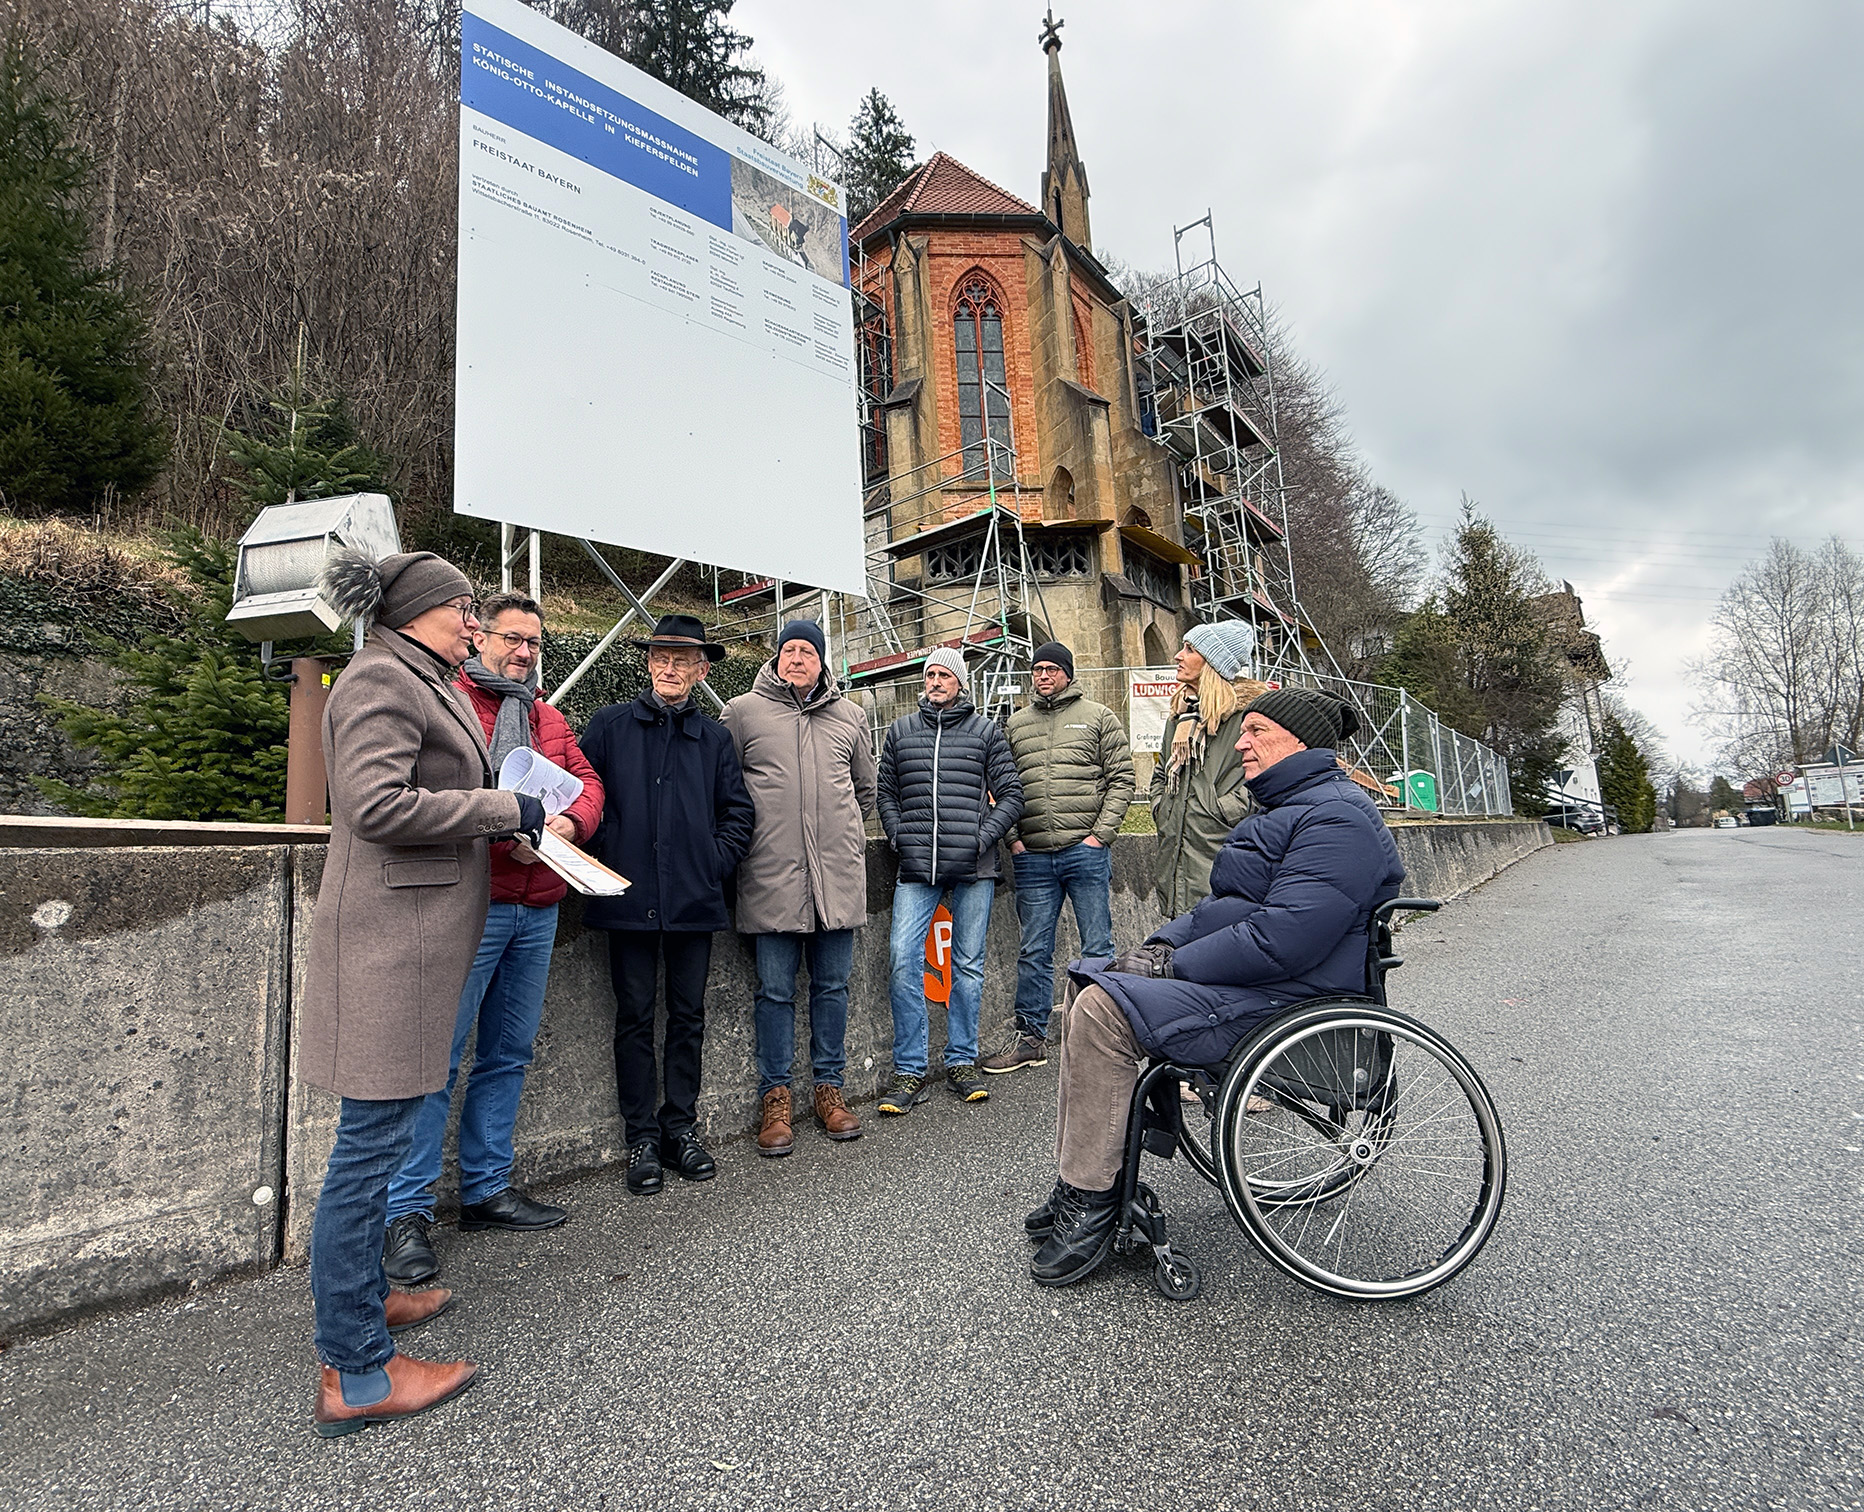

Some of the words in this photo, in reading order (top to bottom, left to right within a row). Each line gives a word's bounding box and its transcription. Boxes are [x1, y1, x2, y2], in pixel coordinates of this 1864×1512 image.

[472, 42, 534, 80] STATISCHE
[545, 79, 698, 166] INSTANDSETZUNGSMASSNAHME
[472, 56, 594, 124] KÖNIG-OTTO-KAPELLE
[604, 123, 615, 134] IN
[624, 134, 698, 178] KIEFERSFELDEN
[472, 124, 506, 144] BAUHERR
[472, 174, 500, 190] vertreten
[501, 186, 518, 196] durch
[473, 139, 535, 173] FREISTAAT
[538, 168, 581, 194] BAYERN
[736, 146, 804, 189] Staatsbauverwaltung
[753, 148, 780, 168] Freistaat
[782, 164, 804, 182] Bayern
[472, 180, 521, 205] STAATLICHES
[523, 201, 552, 218] BAUAMT
[553, 214, 592, 236] ROSENHEIM
[1134, 684, 1176, 696] LUDWIG
[934, 920, 952, 966] P
